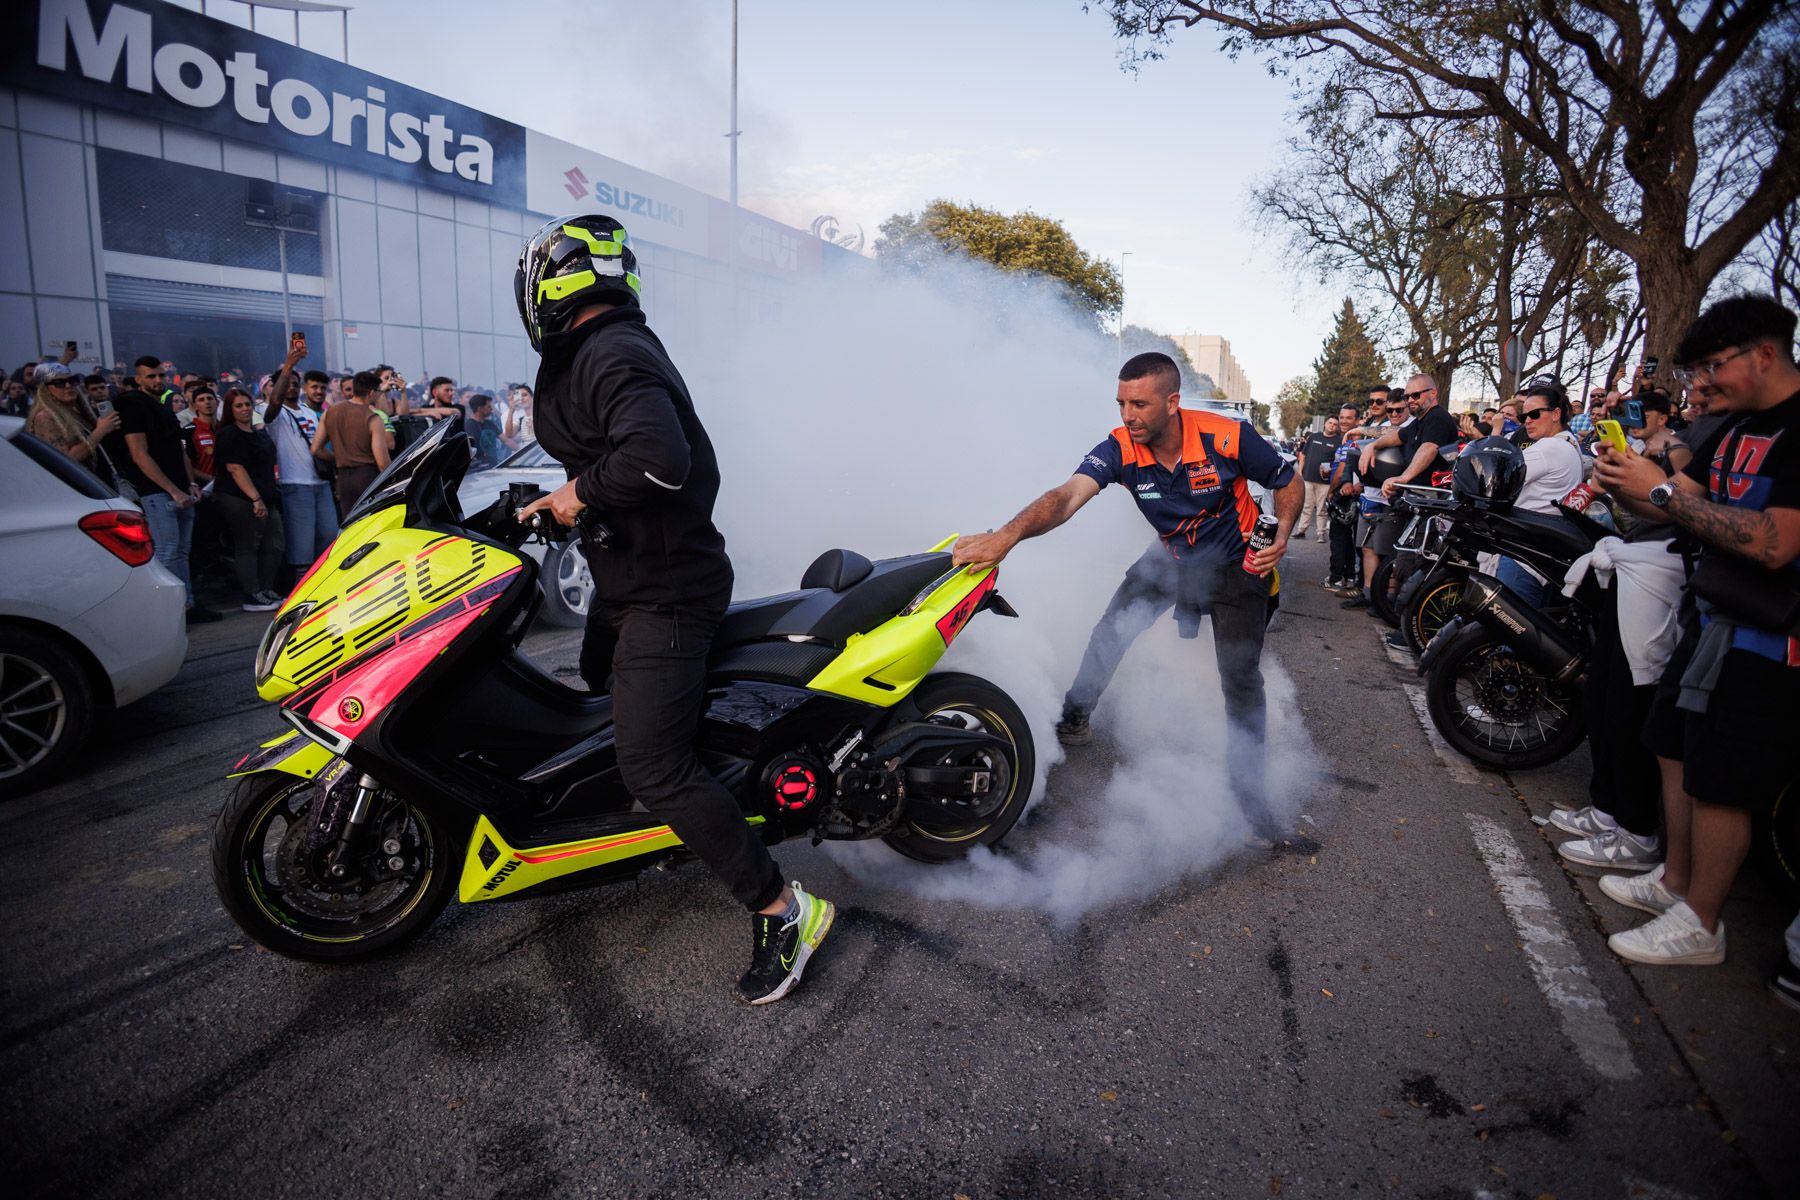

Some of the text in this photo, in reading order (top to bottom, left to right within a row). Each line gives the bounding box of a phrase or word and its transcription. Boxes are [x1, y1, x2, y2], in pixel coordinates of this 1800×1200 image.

[37, 0, 494, 185] Motorista
[595, 181, 685, 228] SUZUKI
[1194, 478, 1216, 487] KTM
[484, 858, 522, 891] MOTUL
